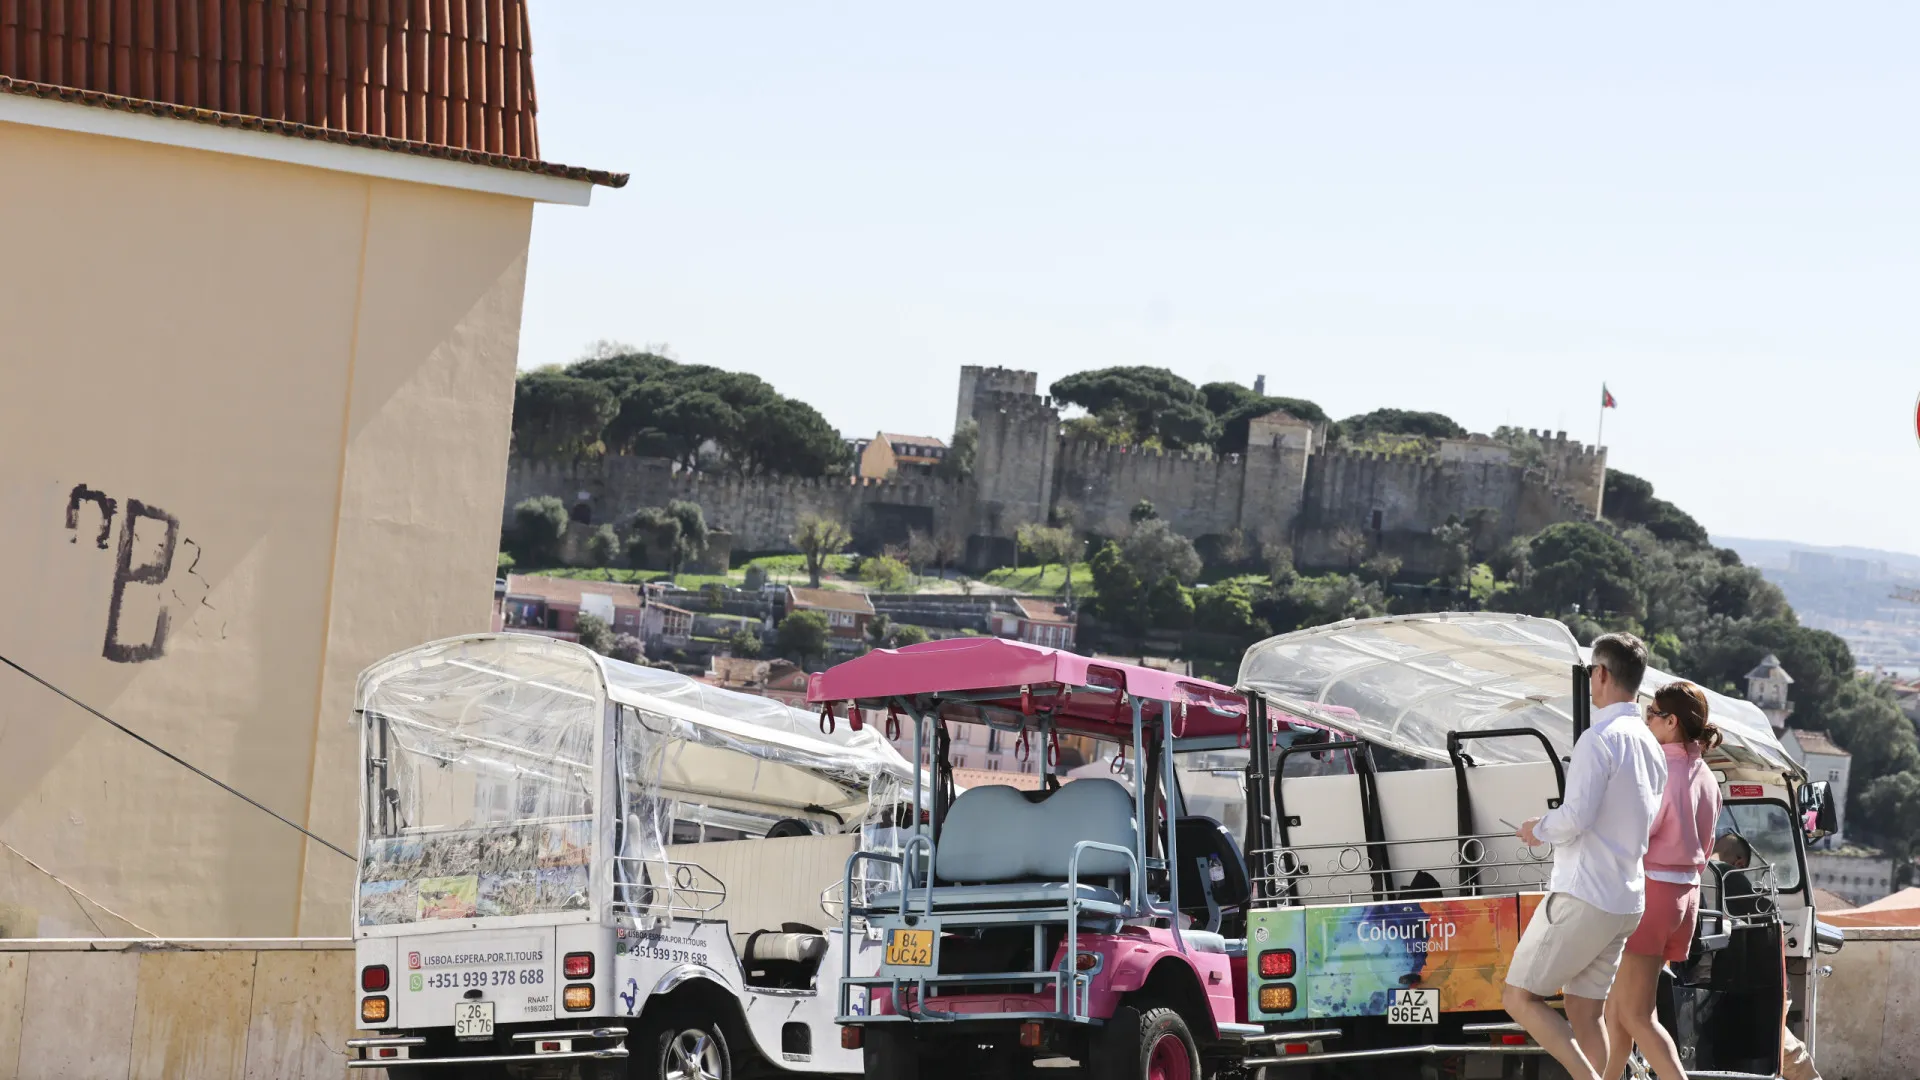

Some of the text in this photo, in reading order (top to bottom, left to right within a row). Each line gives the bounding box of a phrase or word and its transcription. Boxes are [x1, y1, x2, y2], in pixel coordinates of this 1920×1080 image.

[902, 933, 917, 947] 84
[1357, 918, 1456, 950] ColourTrip
[629, 944, 708, 965] +351 939 378 688
[1406, 941, 1444, 953] LISBON
[424, 950, 543, 965] LISBOA.ESPERA.POR.TI.TOURS
[427, 969, 544, 988] +351 939 378 688
[527, 996, 549, 1004] RNAAT
[1402, 991, 1425, 1006] AZ
[468, 1005, 481, 1018] 26
[524, 1005, 553, 1013] 1198/2023
[1391, 1007, 1433, 1022] 96EA
